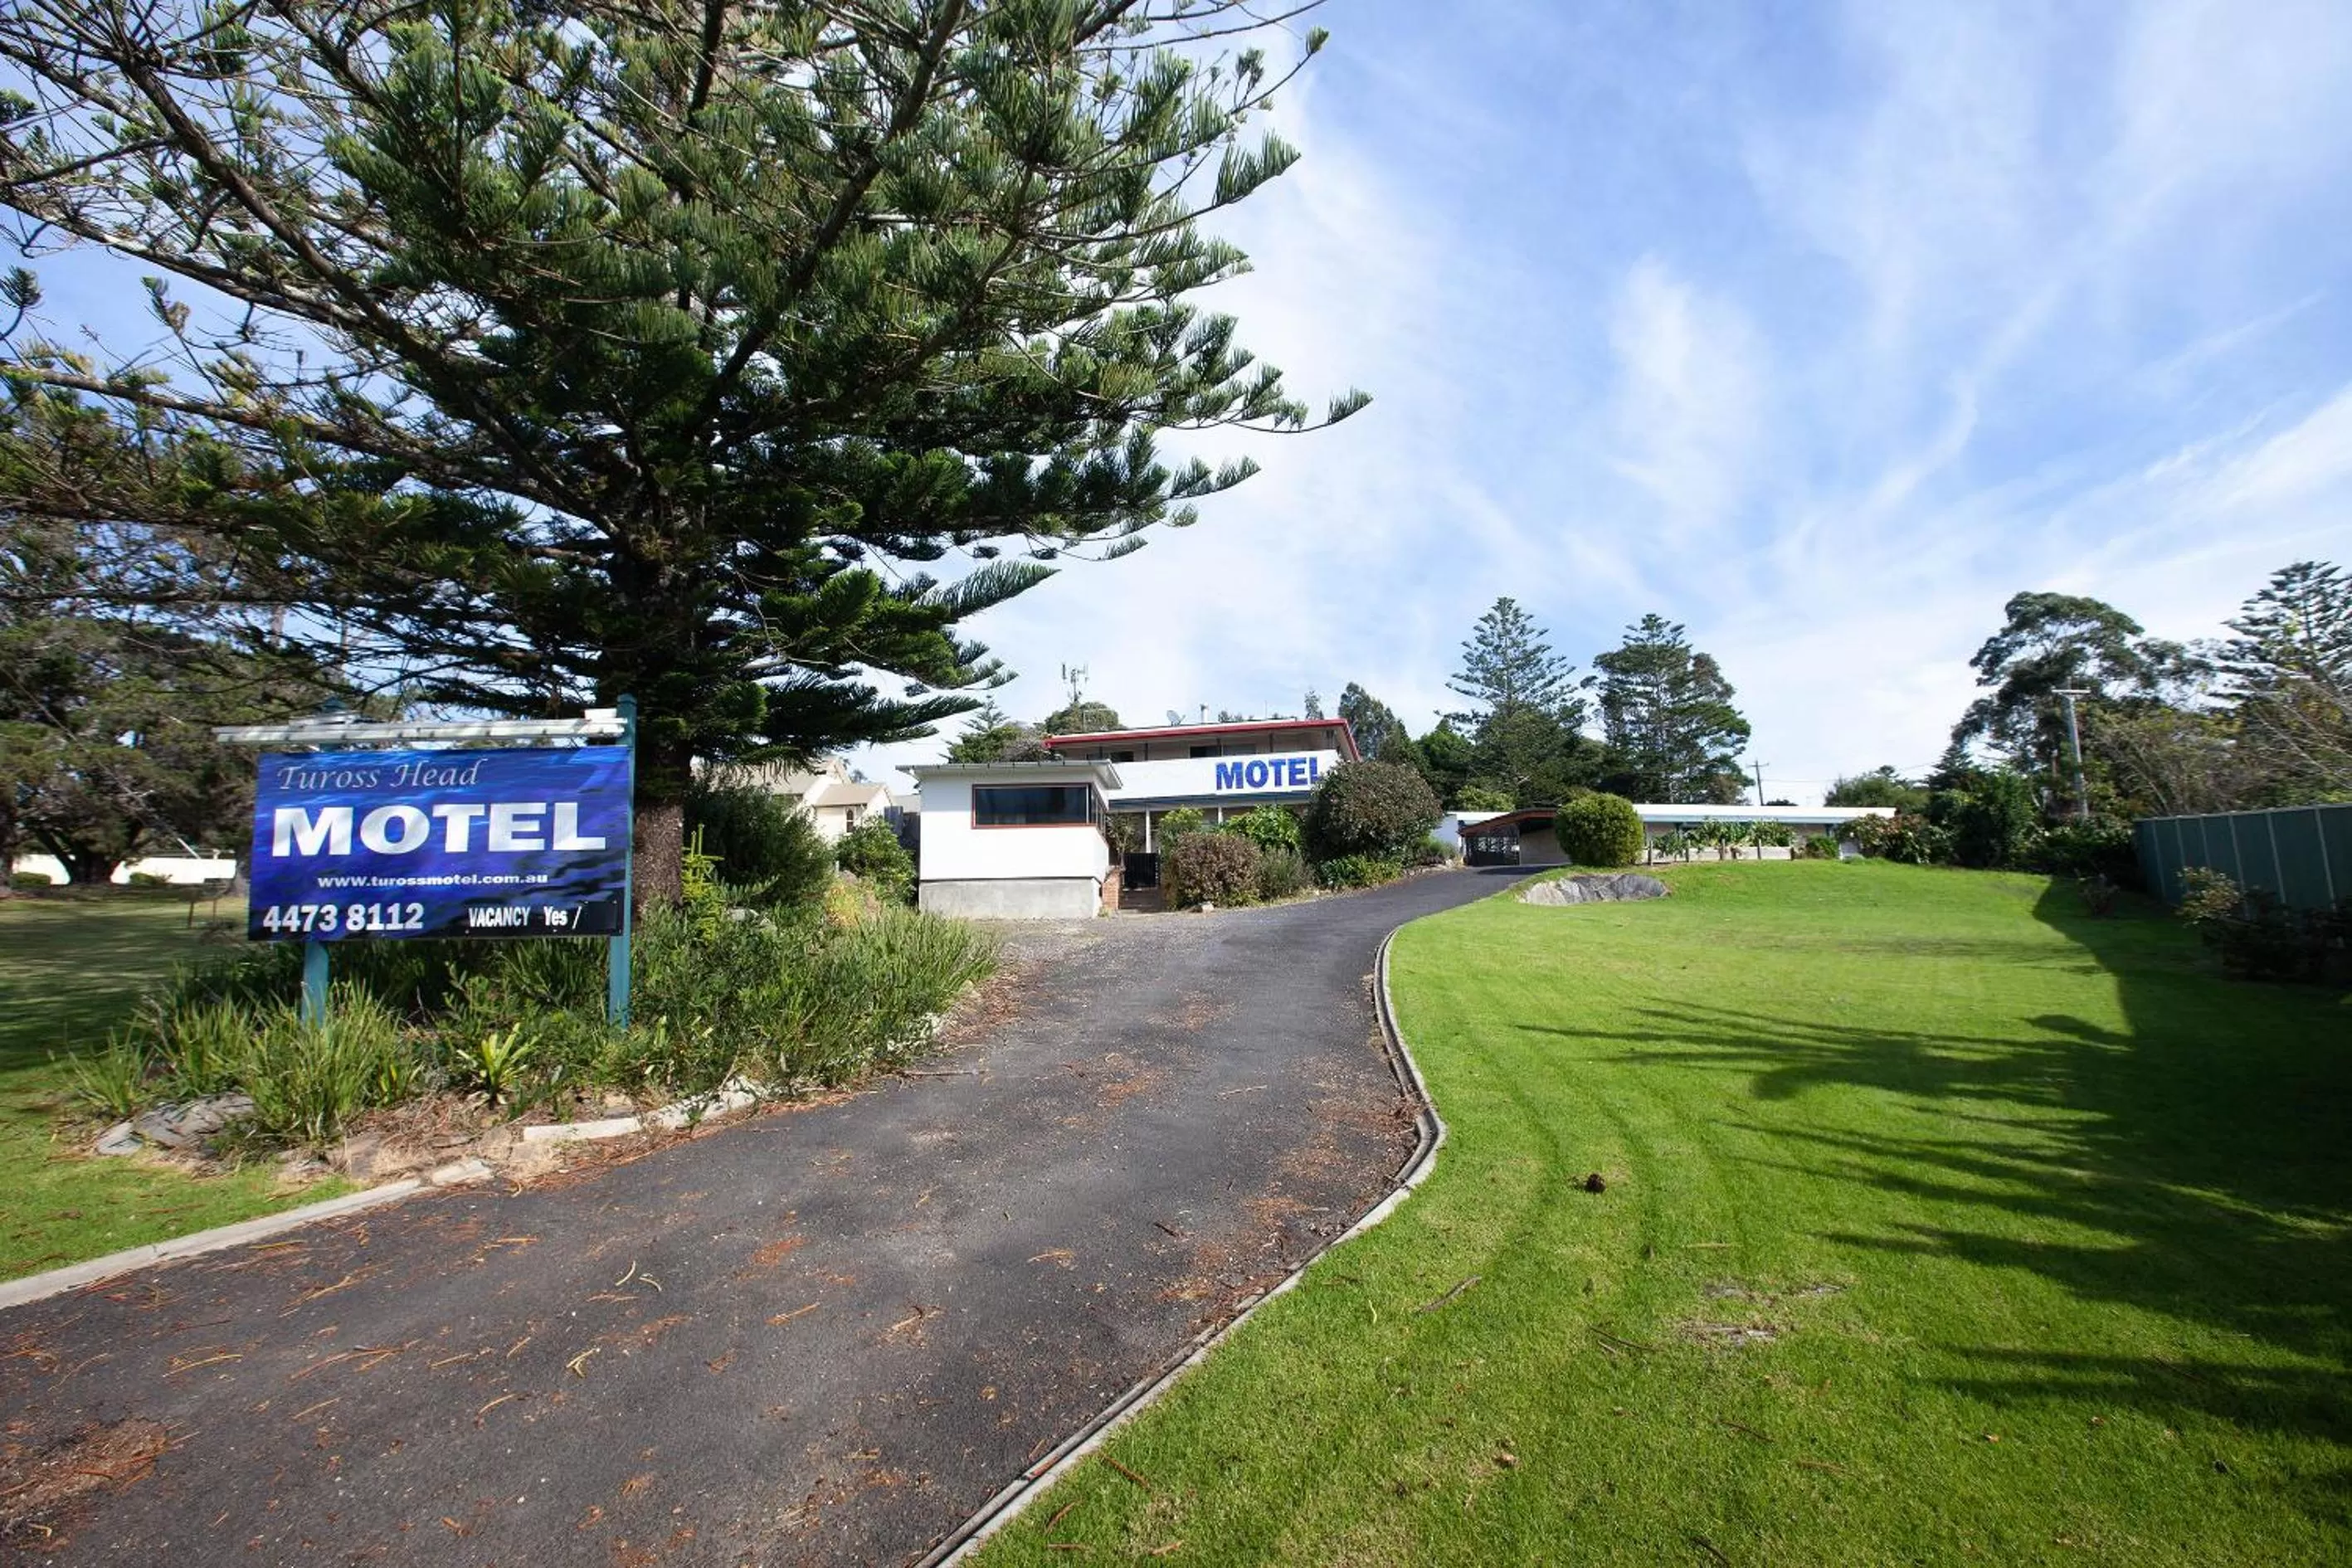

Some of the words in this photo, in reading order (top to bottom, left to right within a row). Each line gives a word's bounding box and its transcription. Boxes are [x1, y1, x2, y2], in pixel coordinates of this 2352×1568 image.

[276, 763, 381, 790] Tuross
[390, 757, 489, 788] Head
[1215, 756, 1319, 791] MOTEL
[271, 801, 606, 858] MOTEL
[318, 874, 548, 888] www.turossmotel.com.au
[262, 904, 338, 933] 4473
[345, 903, 425, 931] 8112
[468, 906, 531, 928] VACANCY
[543, 905, 568, 927] Yes
